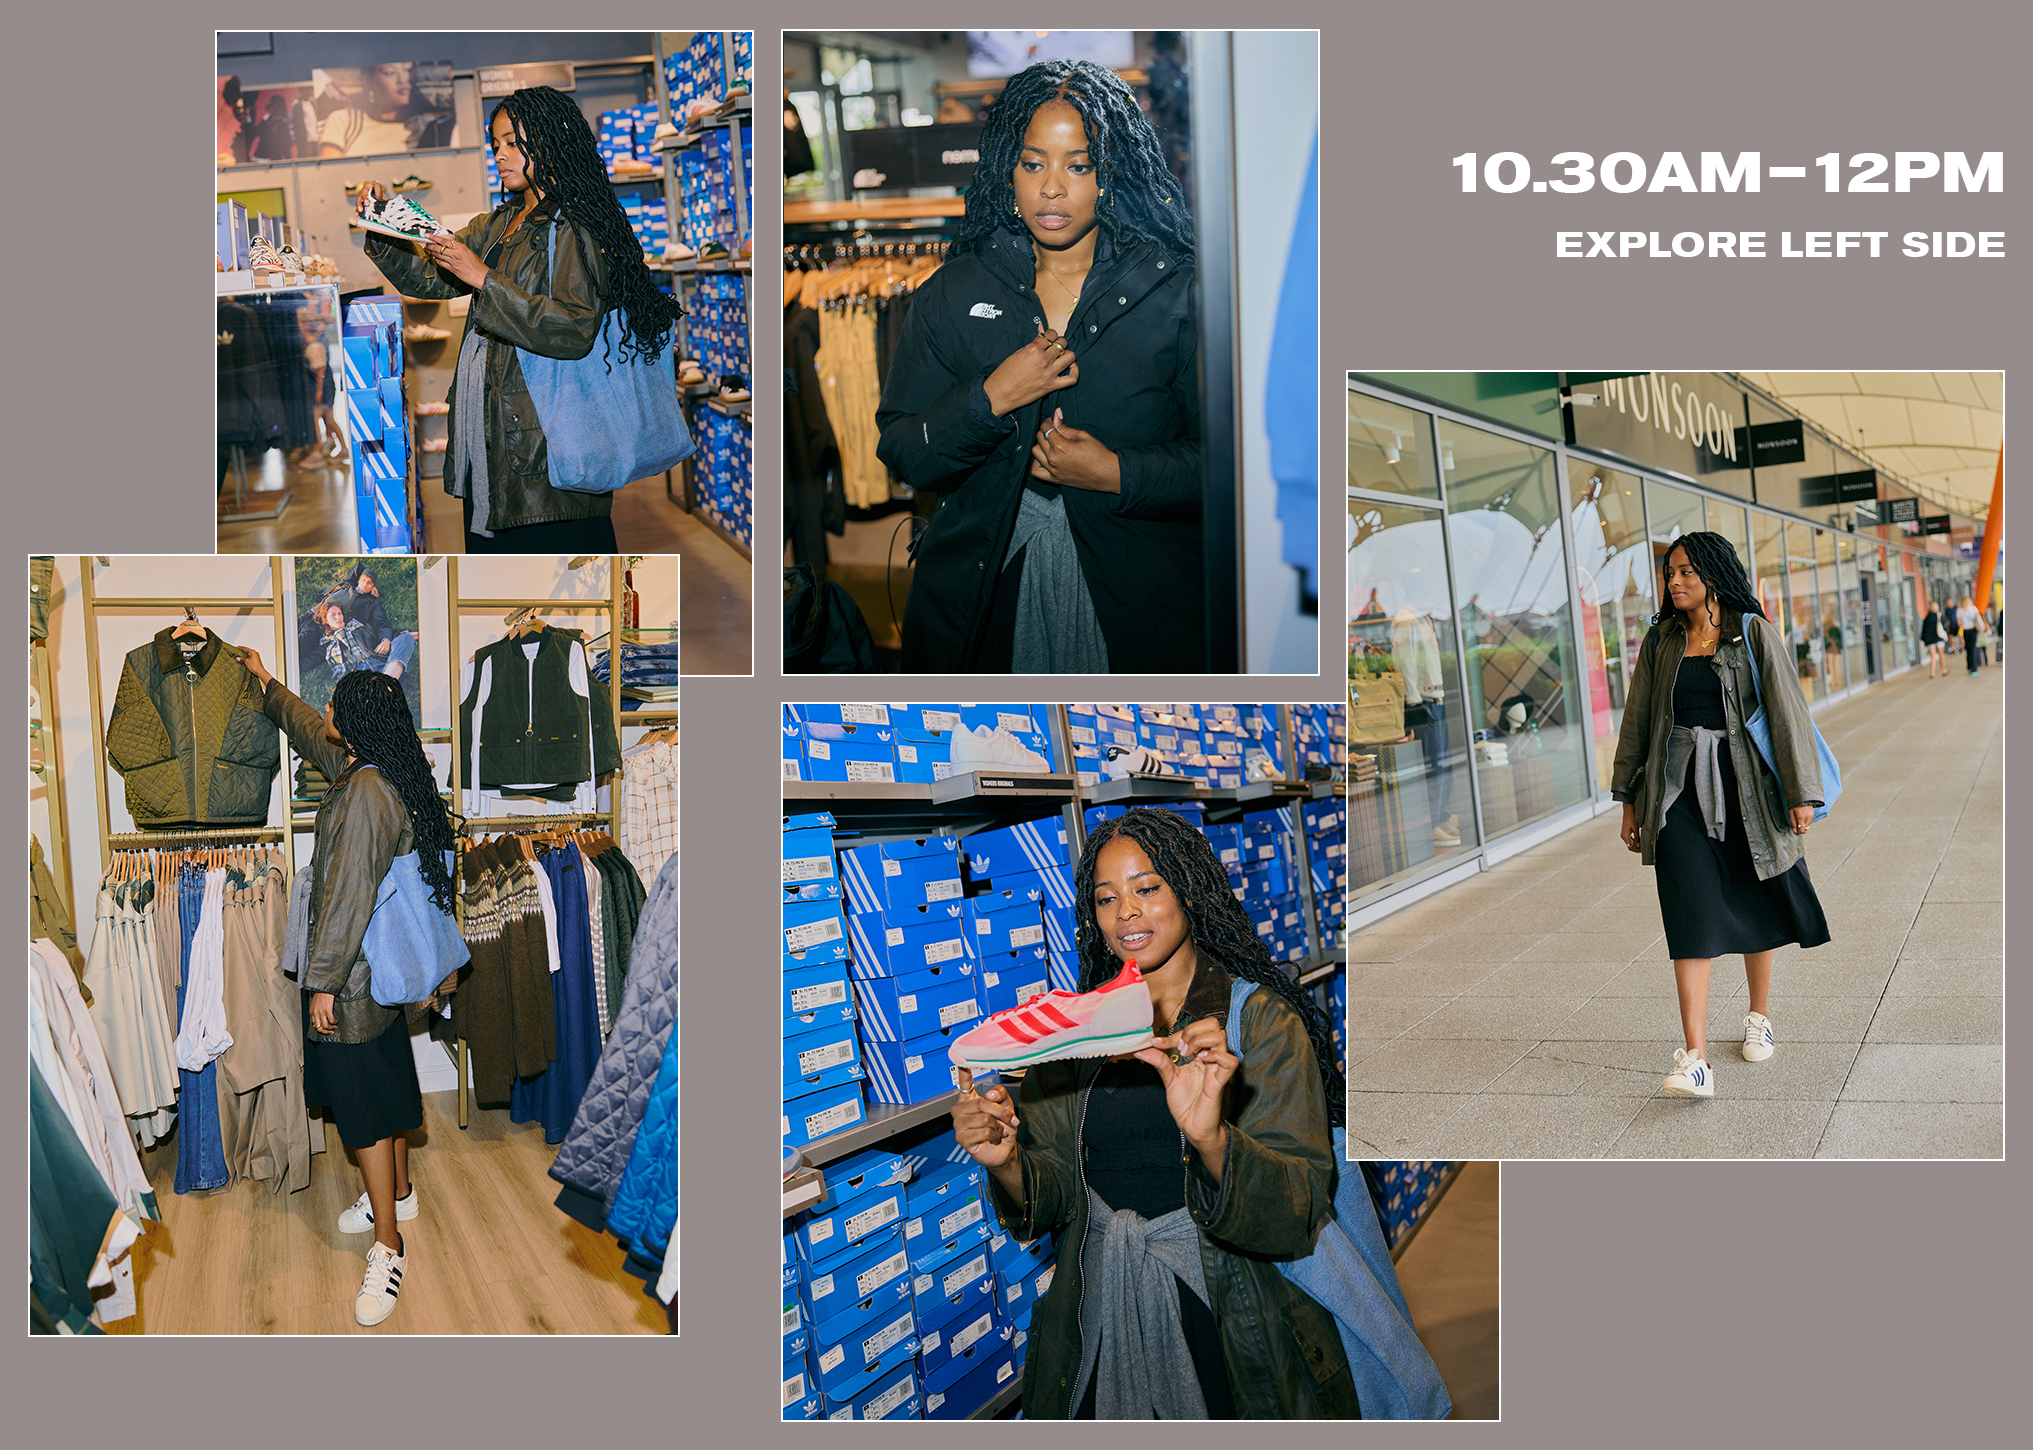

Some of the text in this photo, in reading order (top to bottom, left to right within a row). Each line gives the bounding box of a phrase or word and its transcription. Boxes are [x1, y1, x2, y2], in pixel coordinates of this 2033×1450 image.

[480, 69, 514, 81] WOMEN
[1603, 372, 1737, 462] MONSOON
[1756, 438, 1798, 450] MONSOON
